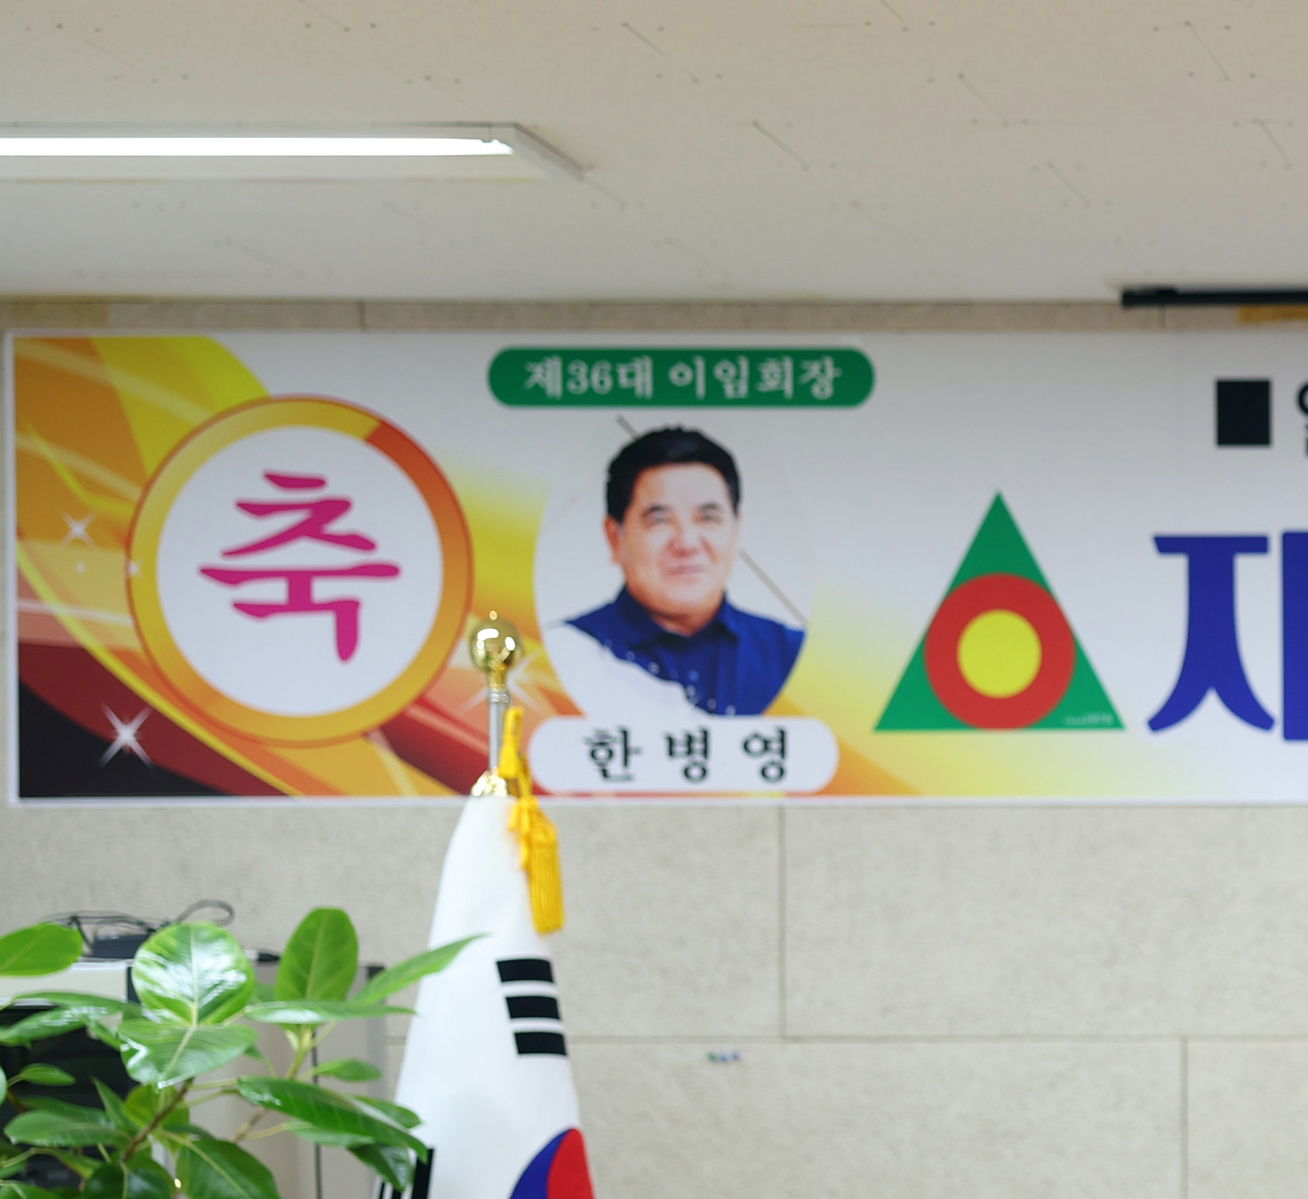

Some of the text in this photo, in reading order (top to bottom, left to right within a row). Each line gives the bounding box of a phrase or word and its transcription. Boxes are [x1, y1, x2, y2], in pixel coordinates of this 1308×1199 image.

[524, 354, 843, 400] 제36대 이임회장
[199, 471, 401, 663] 축
